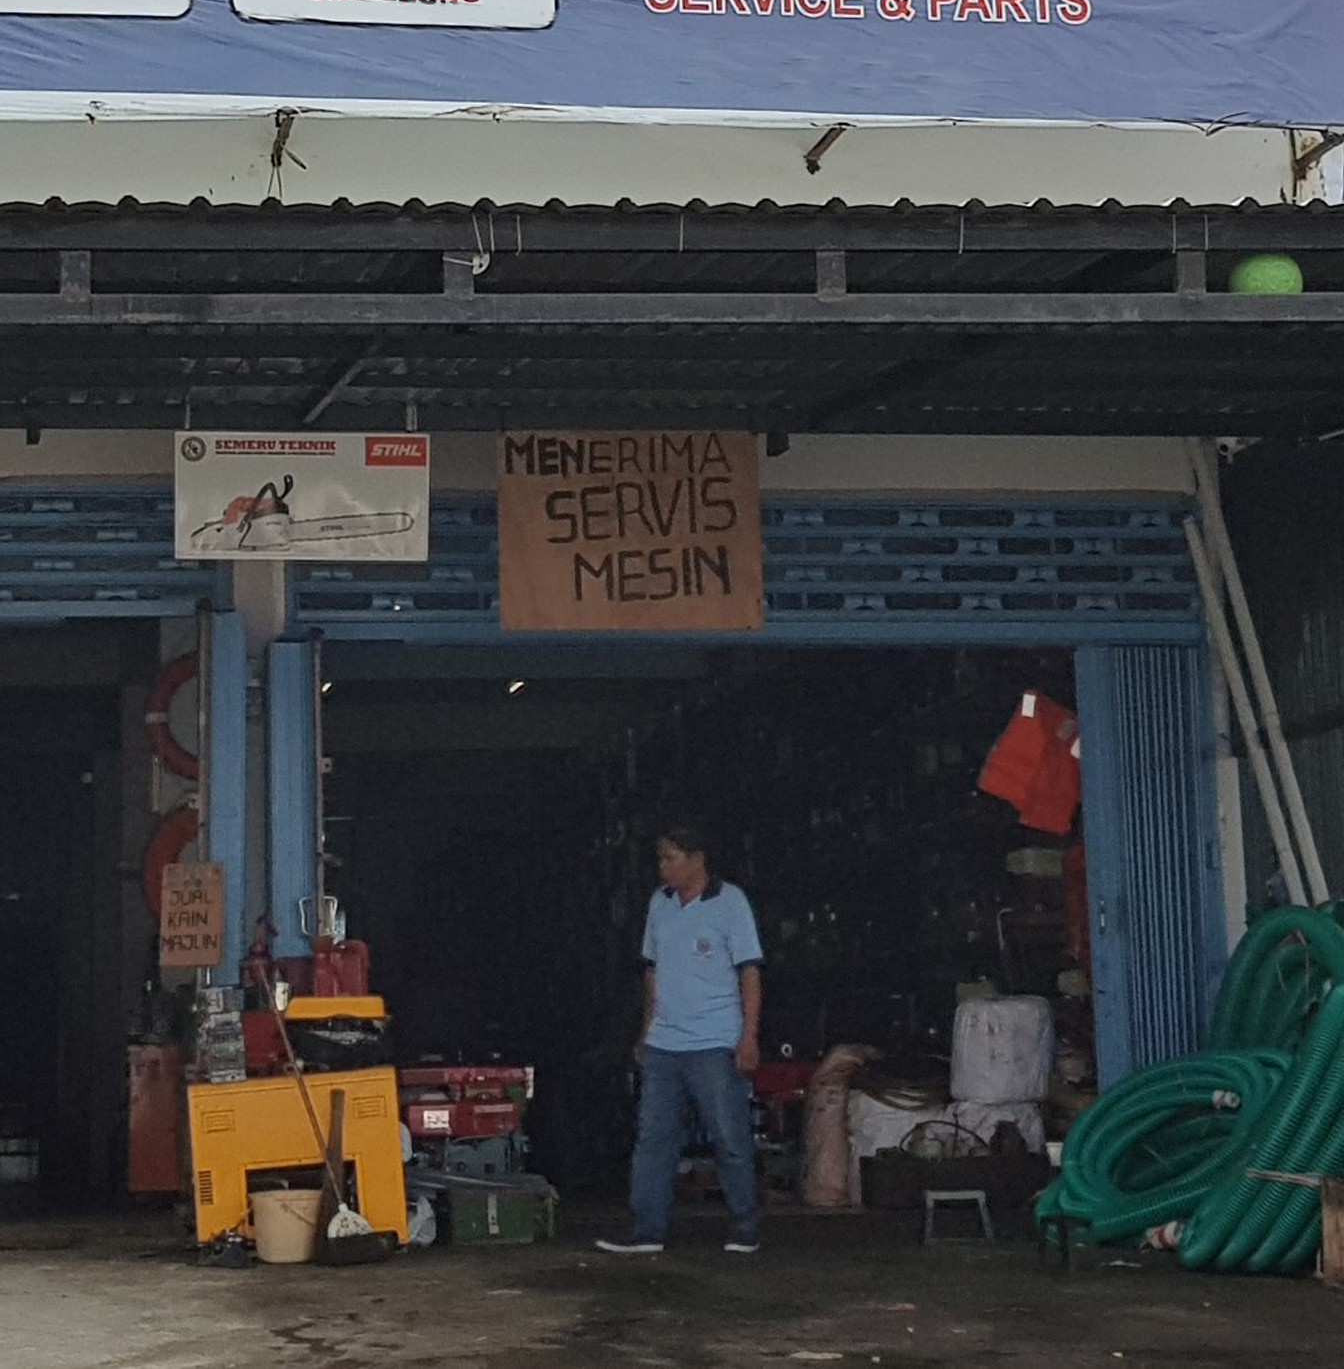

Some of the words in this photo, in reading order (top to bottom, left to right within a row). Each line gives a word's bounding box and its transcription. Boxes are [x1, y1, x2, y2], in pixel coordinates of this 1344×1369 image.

[215, 439, 276, 451] SEMERU
[280, 440, 337, 451] TEKNIK
[370, 443, 422, 457] STIHL
[504, 432, 732, 476] MENERIMA
[545, 476, 738, 544] SERVIS
[574, 544, 732, 602] MESIN
[167, 911, 208, 927] KAIN
